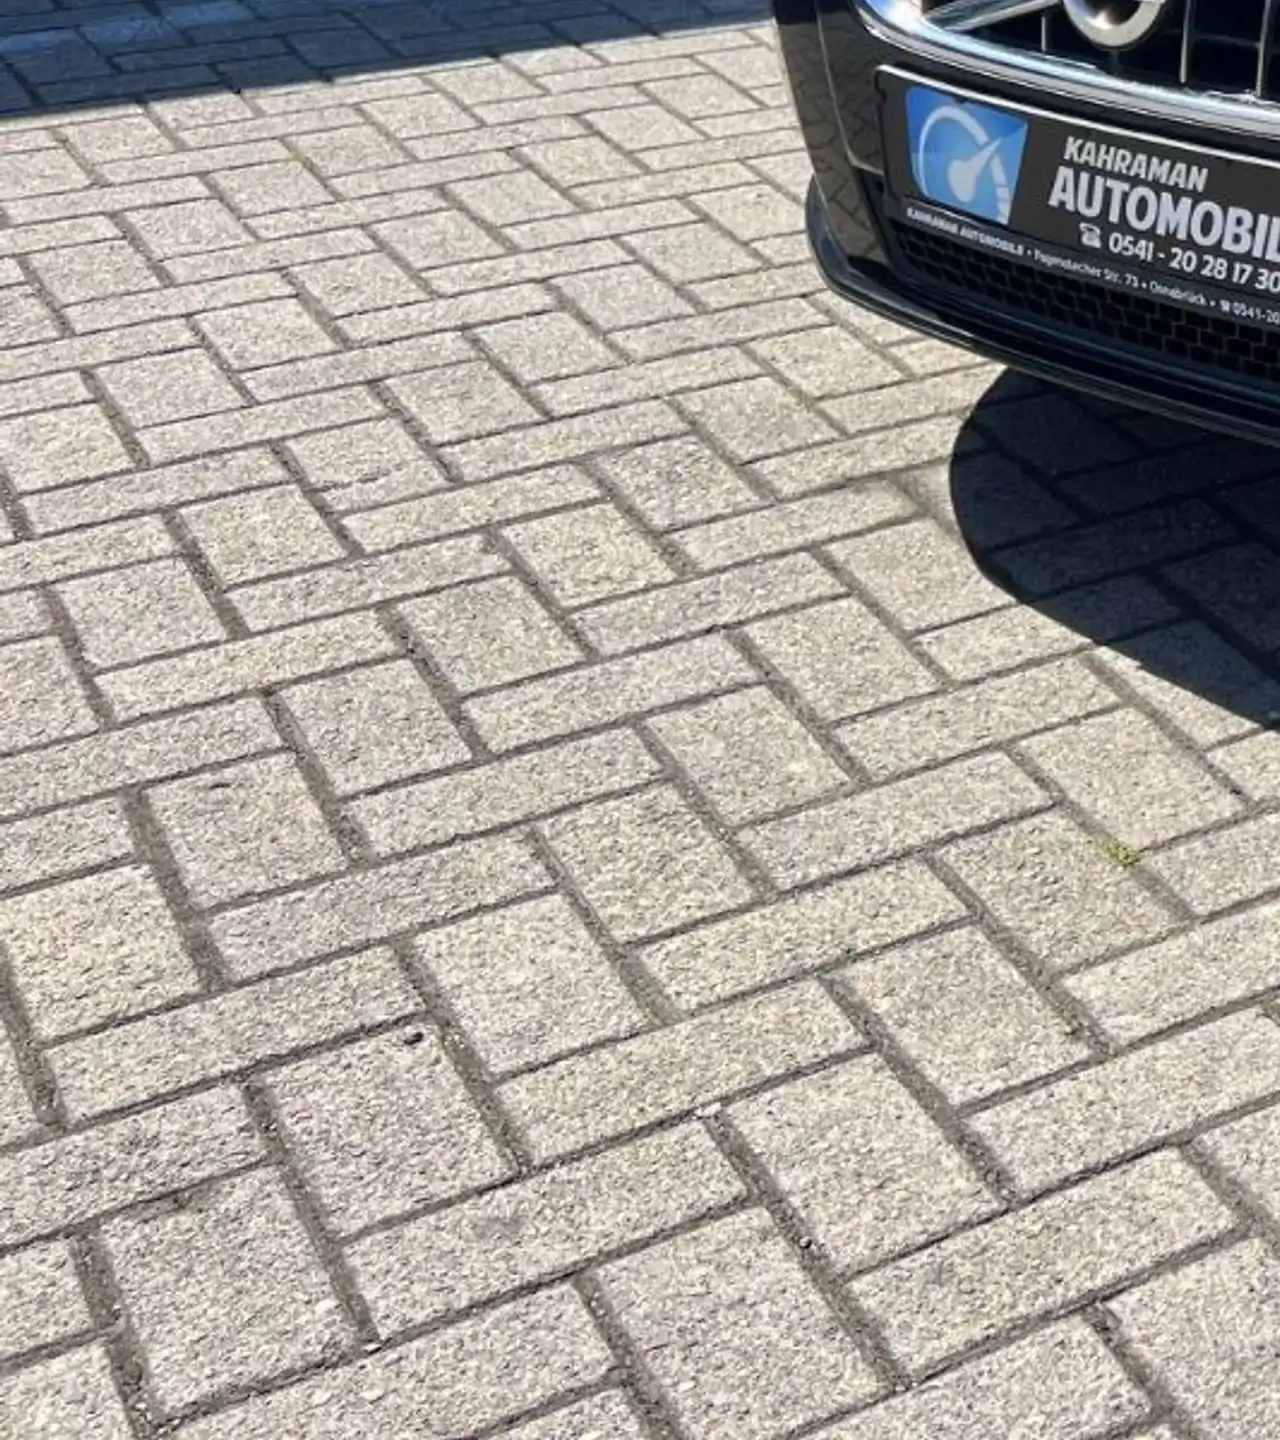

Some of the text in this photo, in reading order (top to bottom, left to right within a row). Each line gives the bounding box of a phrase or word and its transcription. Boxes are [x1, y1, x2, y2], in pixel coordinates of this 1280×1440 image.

[1063, 136, 1209, 192] KAHRAMAN
[1108, 231, 1154, 262] 0541
[1168, 246, 1198, 273] 20
[1200, 254, 1229, 280] 28
[1231, 262, 1254, 285] 17
